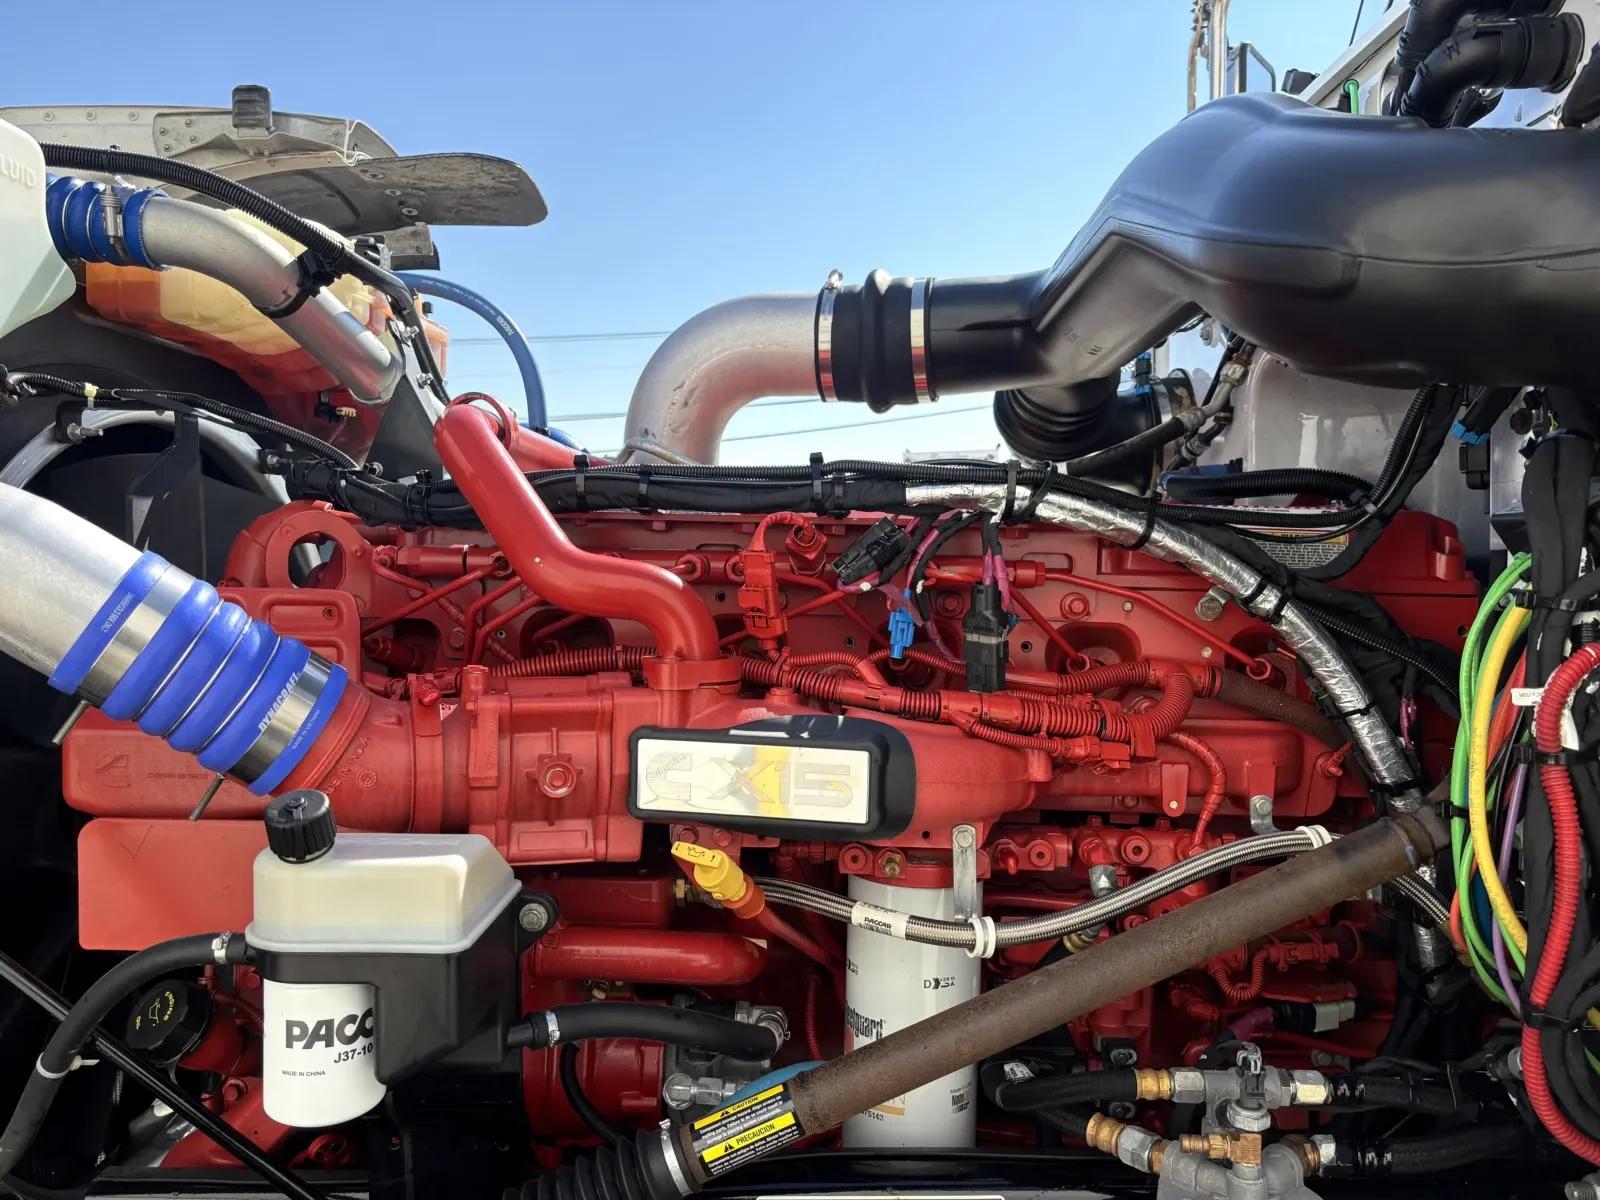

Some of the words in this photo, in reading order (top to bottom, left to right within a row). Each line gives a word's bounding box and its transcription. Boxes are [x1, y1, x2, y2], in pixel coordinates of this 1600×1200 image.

[0, 153, 37, 188] LUID
[864, 916, 892, 930] PACCAR
[164, 990, 175, 1021] ENGINE
[285, 1008, 374, 1049] PACC
[333, 1042, 373, 1063] J37-10
[282, 1069, 297, 1077] MADE
[732, 1096, 757, 1110] CAUTION
[736, 1122, 774, 1145] PRECAUCION
